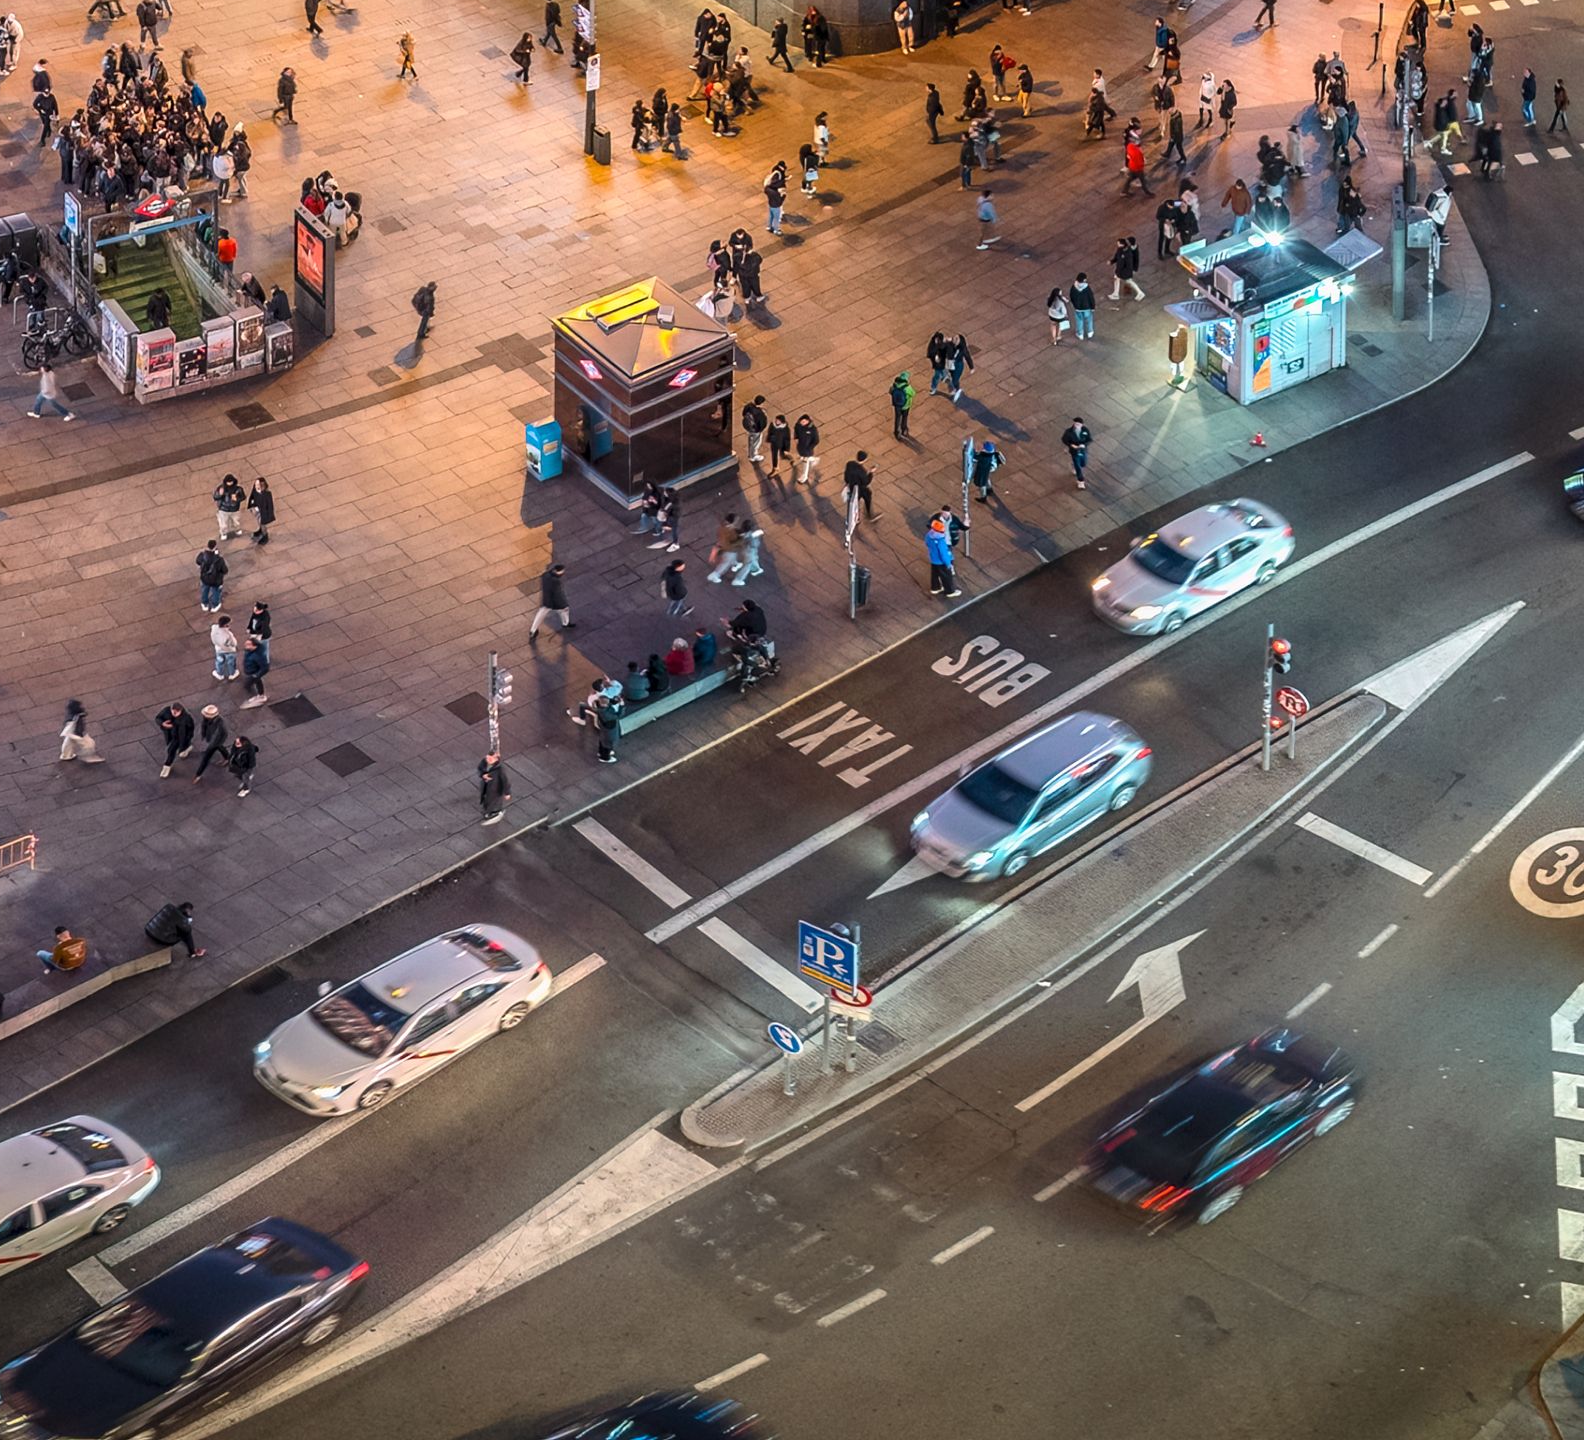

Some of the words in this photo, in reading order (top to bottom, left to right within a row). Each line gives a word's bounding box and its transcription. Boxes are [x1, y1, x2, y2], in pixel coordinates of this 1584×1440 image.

[931, 634, 1053, 708] BUS
[776, 700, 913, 789] TAXI
[812, 932, 845, 969] P
